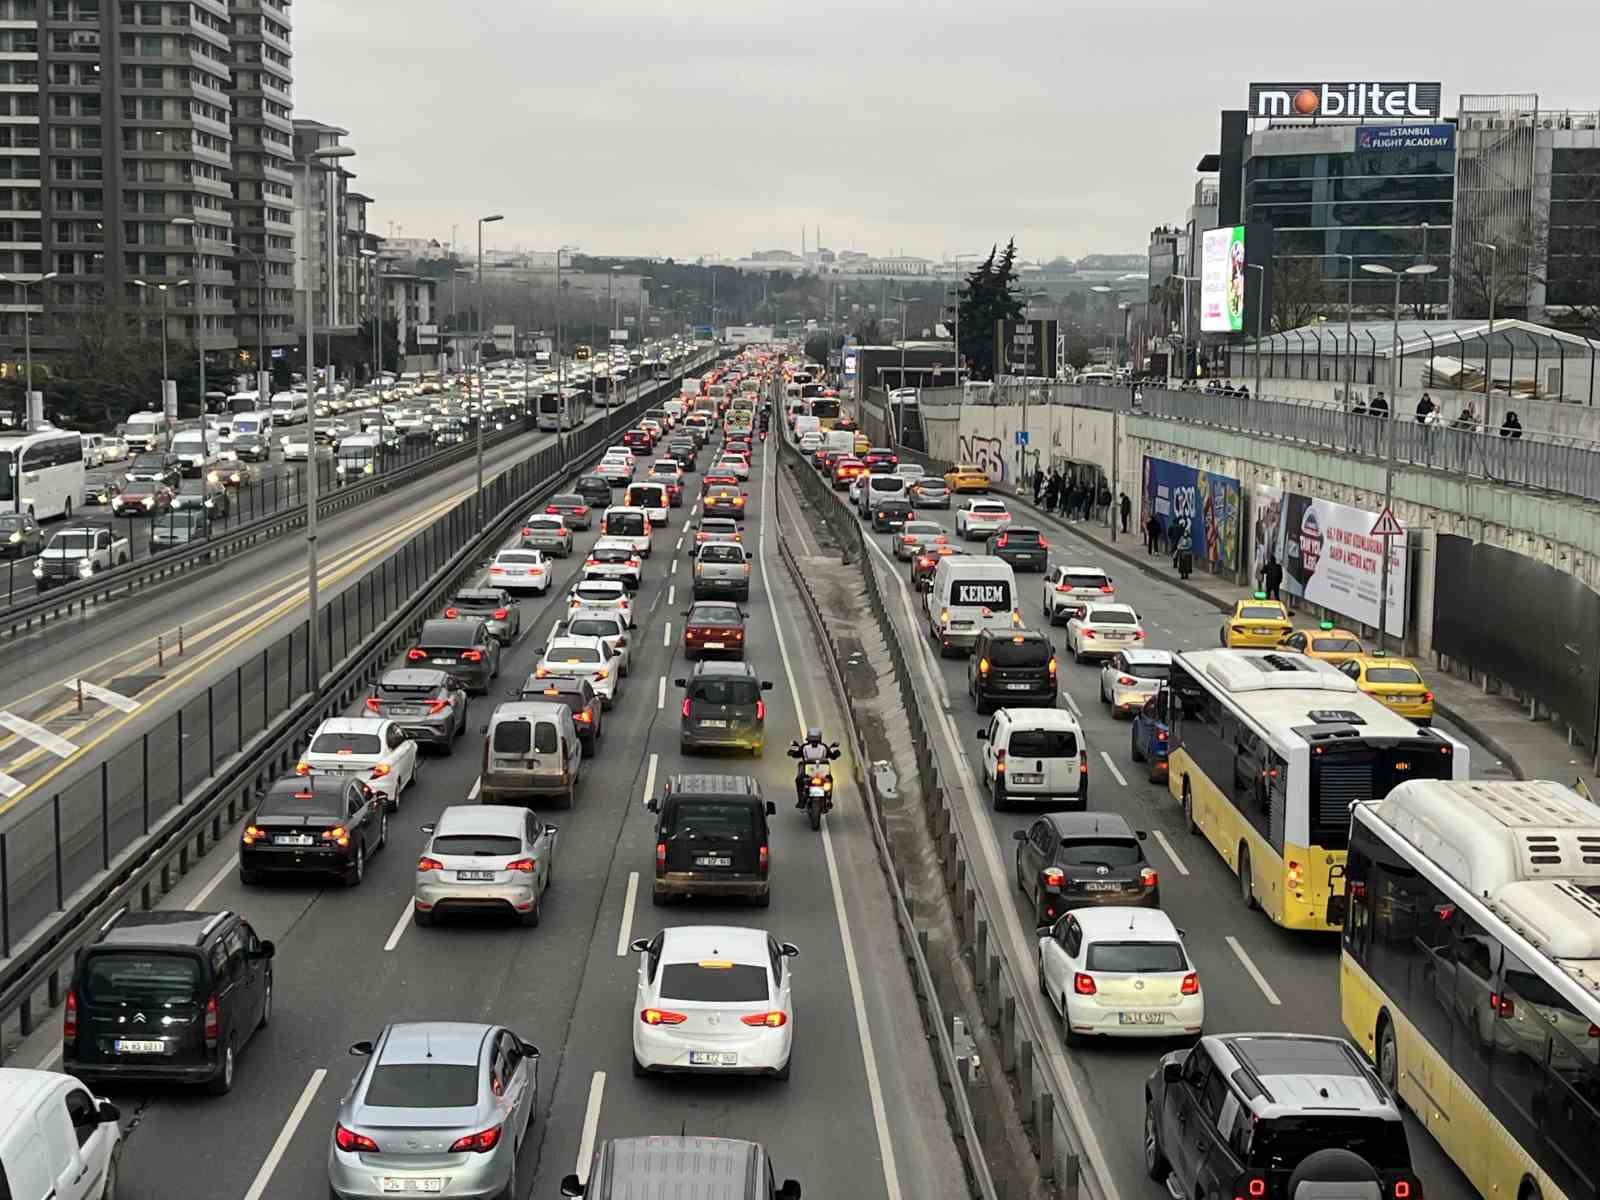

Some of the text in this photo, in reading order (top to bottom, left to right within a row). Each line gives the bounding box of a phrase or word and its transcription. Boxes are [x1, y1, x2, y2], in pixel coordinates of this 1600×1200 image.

[1372, 137, 1448, 147] FLIGHT ACADEMY
[960, 585, 1003, 602] KEREM
